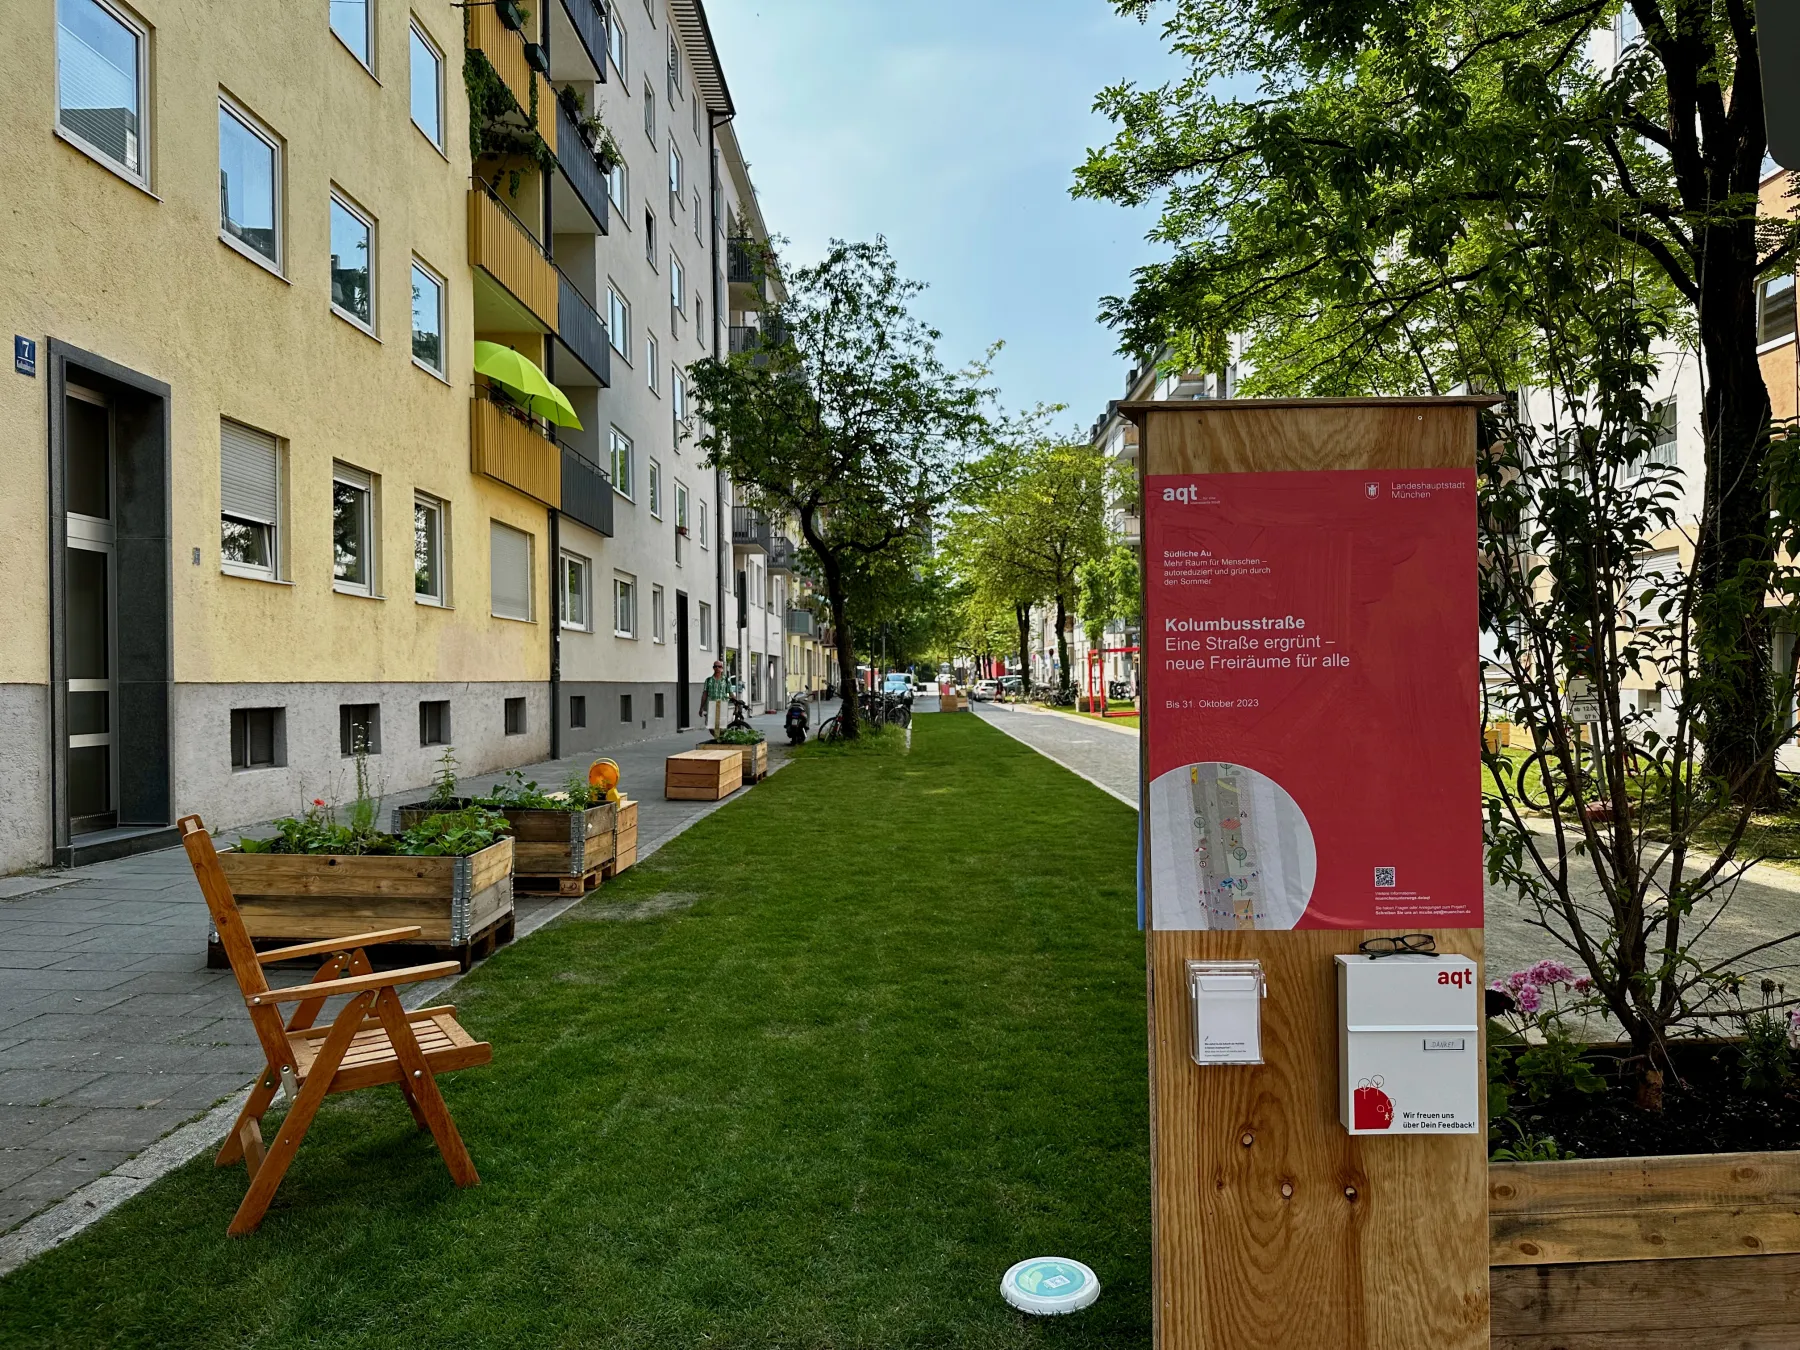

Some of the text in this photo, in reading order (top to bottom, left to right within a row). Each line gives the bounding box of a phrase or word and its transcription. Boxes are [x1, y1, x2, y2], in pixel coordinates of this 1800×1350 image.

[21, 340, 30, 358] 7
[1391, 481, 1466, 491] Landeshauptstadt
[1162, 483, 1198, 505] aqt
[1391, 490, 1431, 499] München
[1163, 549, 1212, 558] Südliche Au
[1209, 558, 1220, 566] für
[1221, 558, 1260, 566] Menschen
[1163, 566, 1271, 577] autoreduziert und grün durch
[1165, 615, 1306, 632] Kolumbusstraße
[1165, 637, 1201, 651] Eine
[1206, 635, 1259, 650] Straße
[1264, 635, 1321, 652] ergrünt
[1165, 654, 1350, 670] neue Freiräume für alle
[1166, 699, 1260, 709] Bis 31. Oktober 2023
[1437, 968, 1473, 989] aqt
[1402, 1111, 1415, 1119] Wir
[1402, 1121, 1475, 1129] über Dein Feedback!
